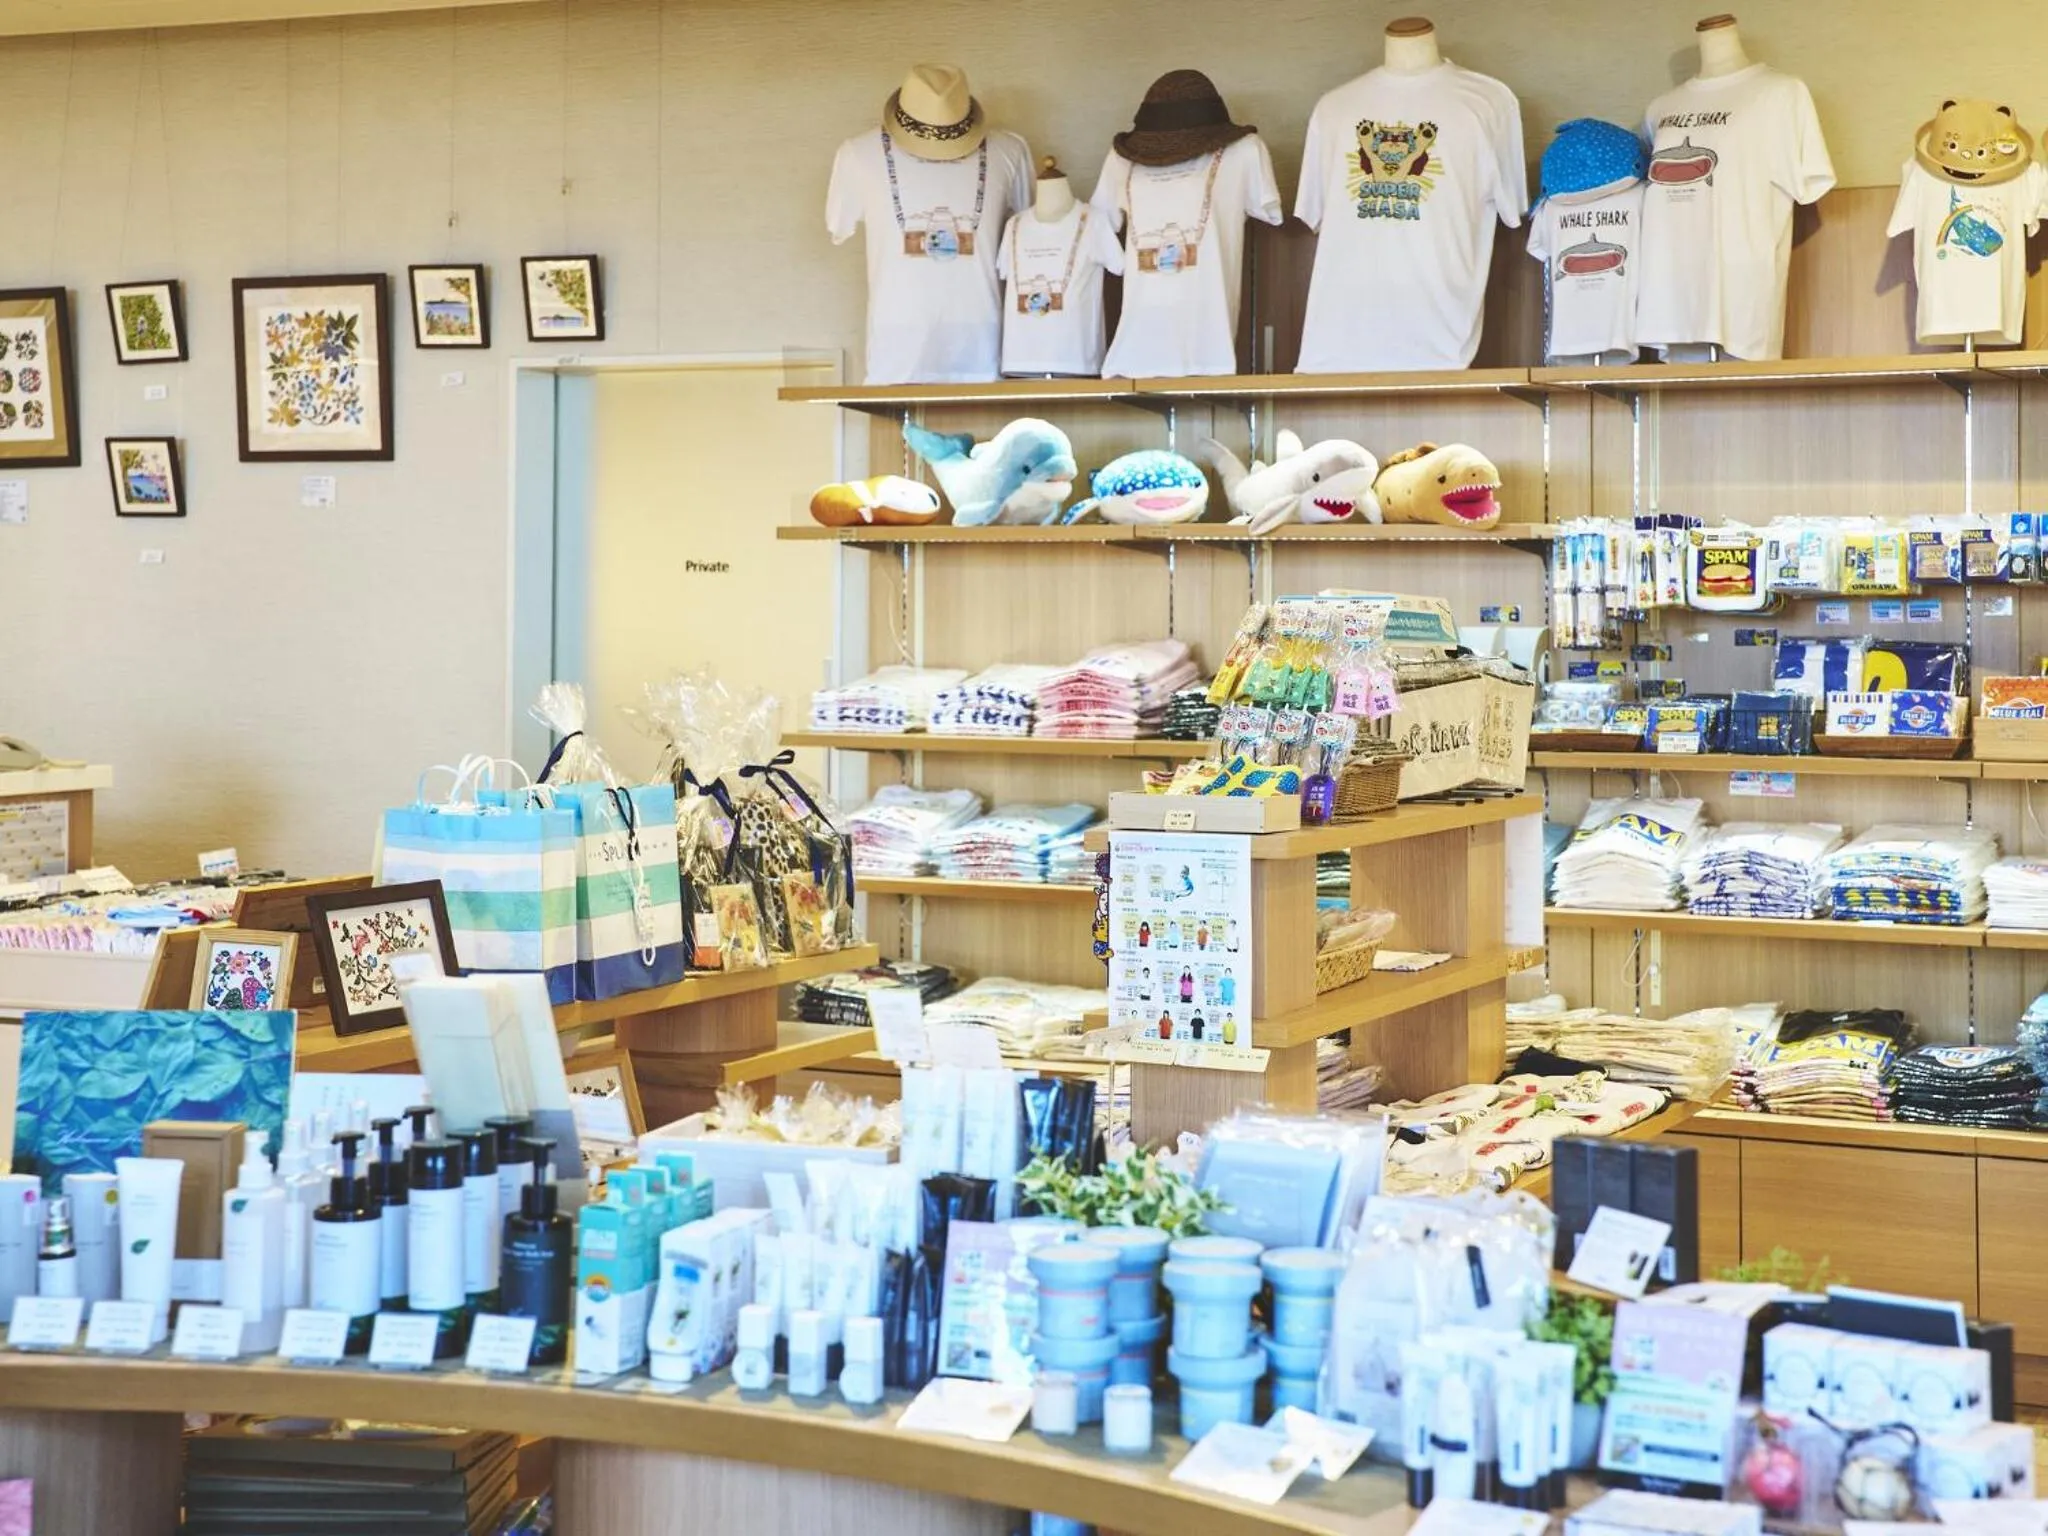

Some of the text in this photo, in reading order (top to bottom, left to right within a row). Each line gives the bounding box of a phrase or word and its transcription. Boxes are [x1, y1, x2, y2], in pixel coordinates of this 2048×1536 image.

[1658, 111, 1731, 129] WHALE SHARK
[1359, 181, 1421, 201] SUPER
[1559, 209, 1629, 230] WHALE SHARK
[1704, 550, 1749, 564] SPAM
[685, 559, 730, 573] Private
[1851, 583, 1899, 592] OKINAWA
[1659, 709, 1697, 721] SPAM
[1994, 707, 2042, 718] BLUE SEAL
